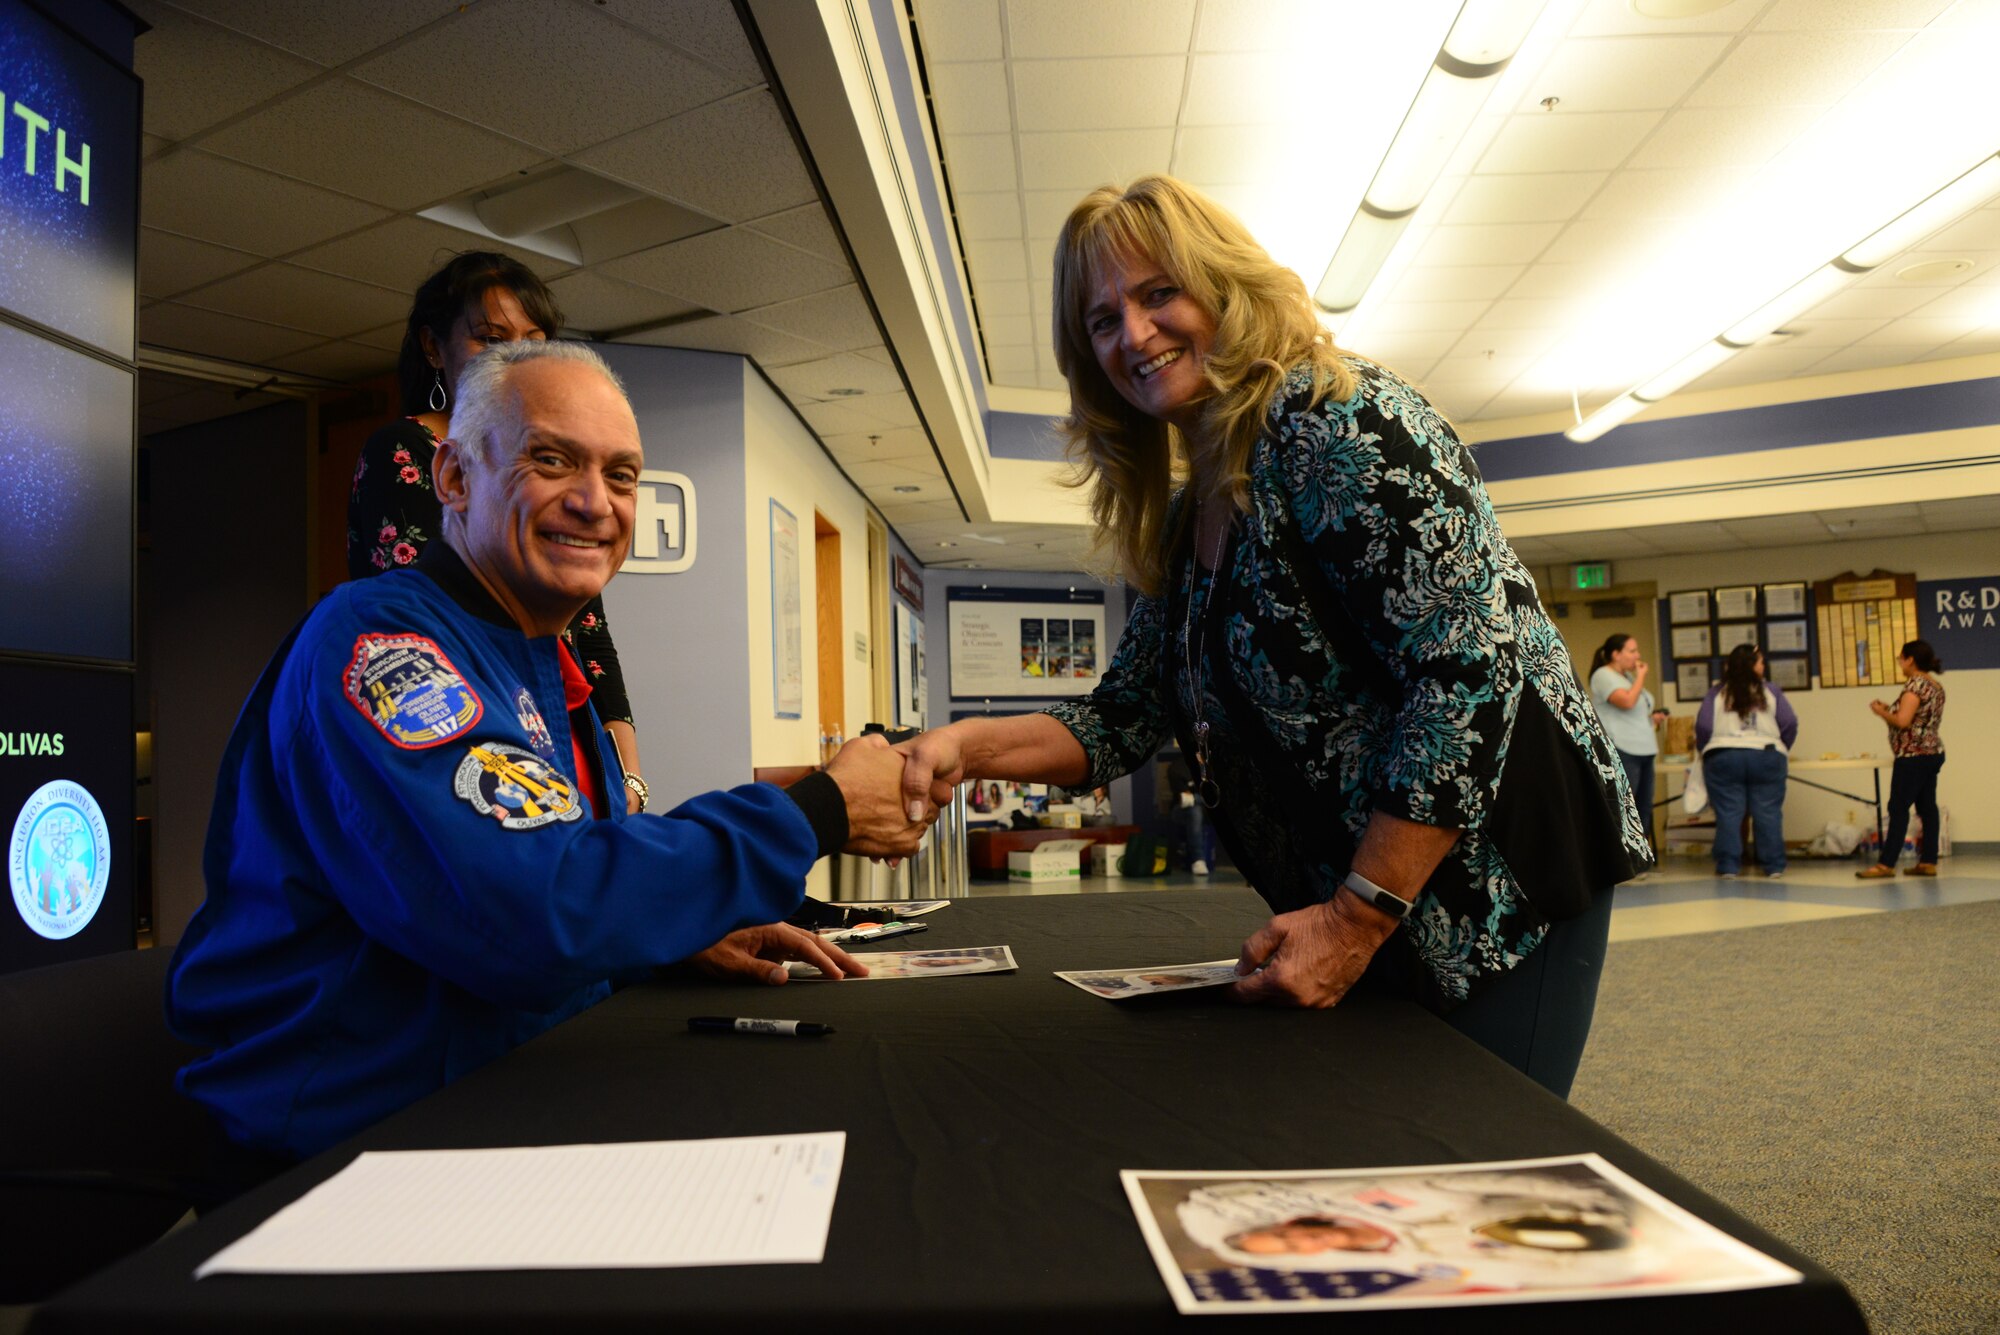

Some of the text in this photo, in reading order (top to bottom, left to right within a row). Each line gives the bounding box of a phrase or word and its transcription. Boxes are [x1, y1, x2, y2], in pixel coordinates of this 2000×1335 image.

[363, 647, 409, 678] STURCKOW
[418, 701, 448, 720] OLIVAS
[430, 715, 458, 737] 117
[516, 816, 549, 827] OLIVAS
